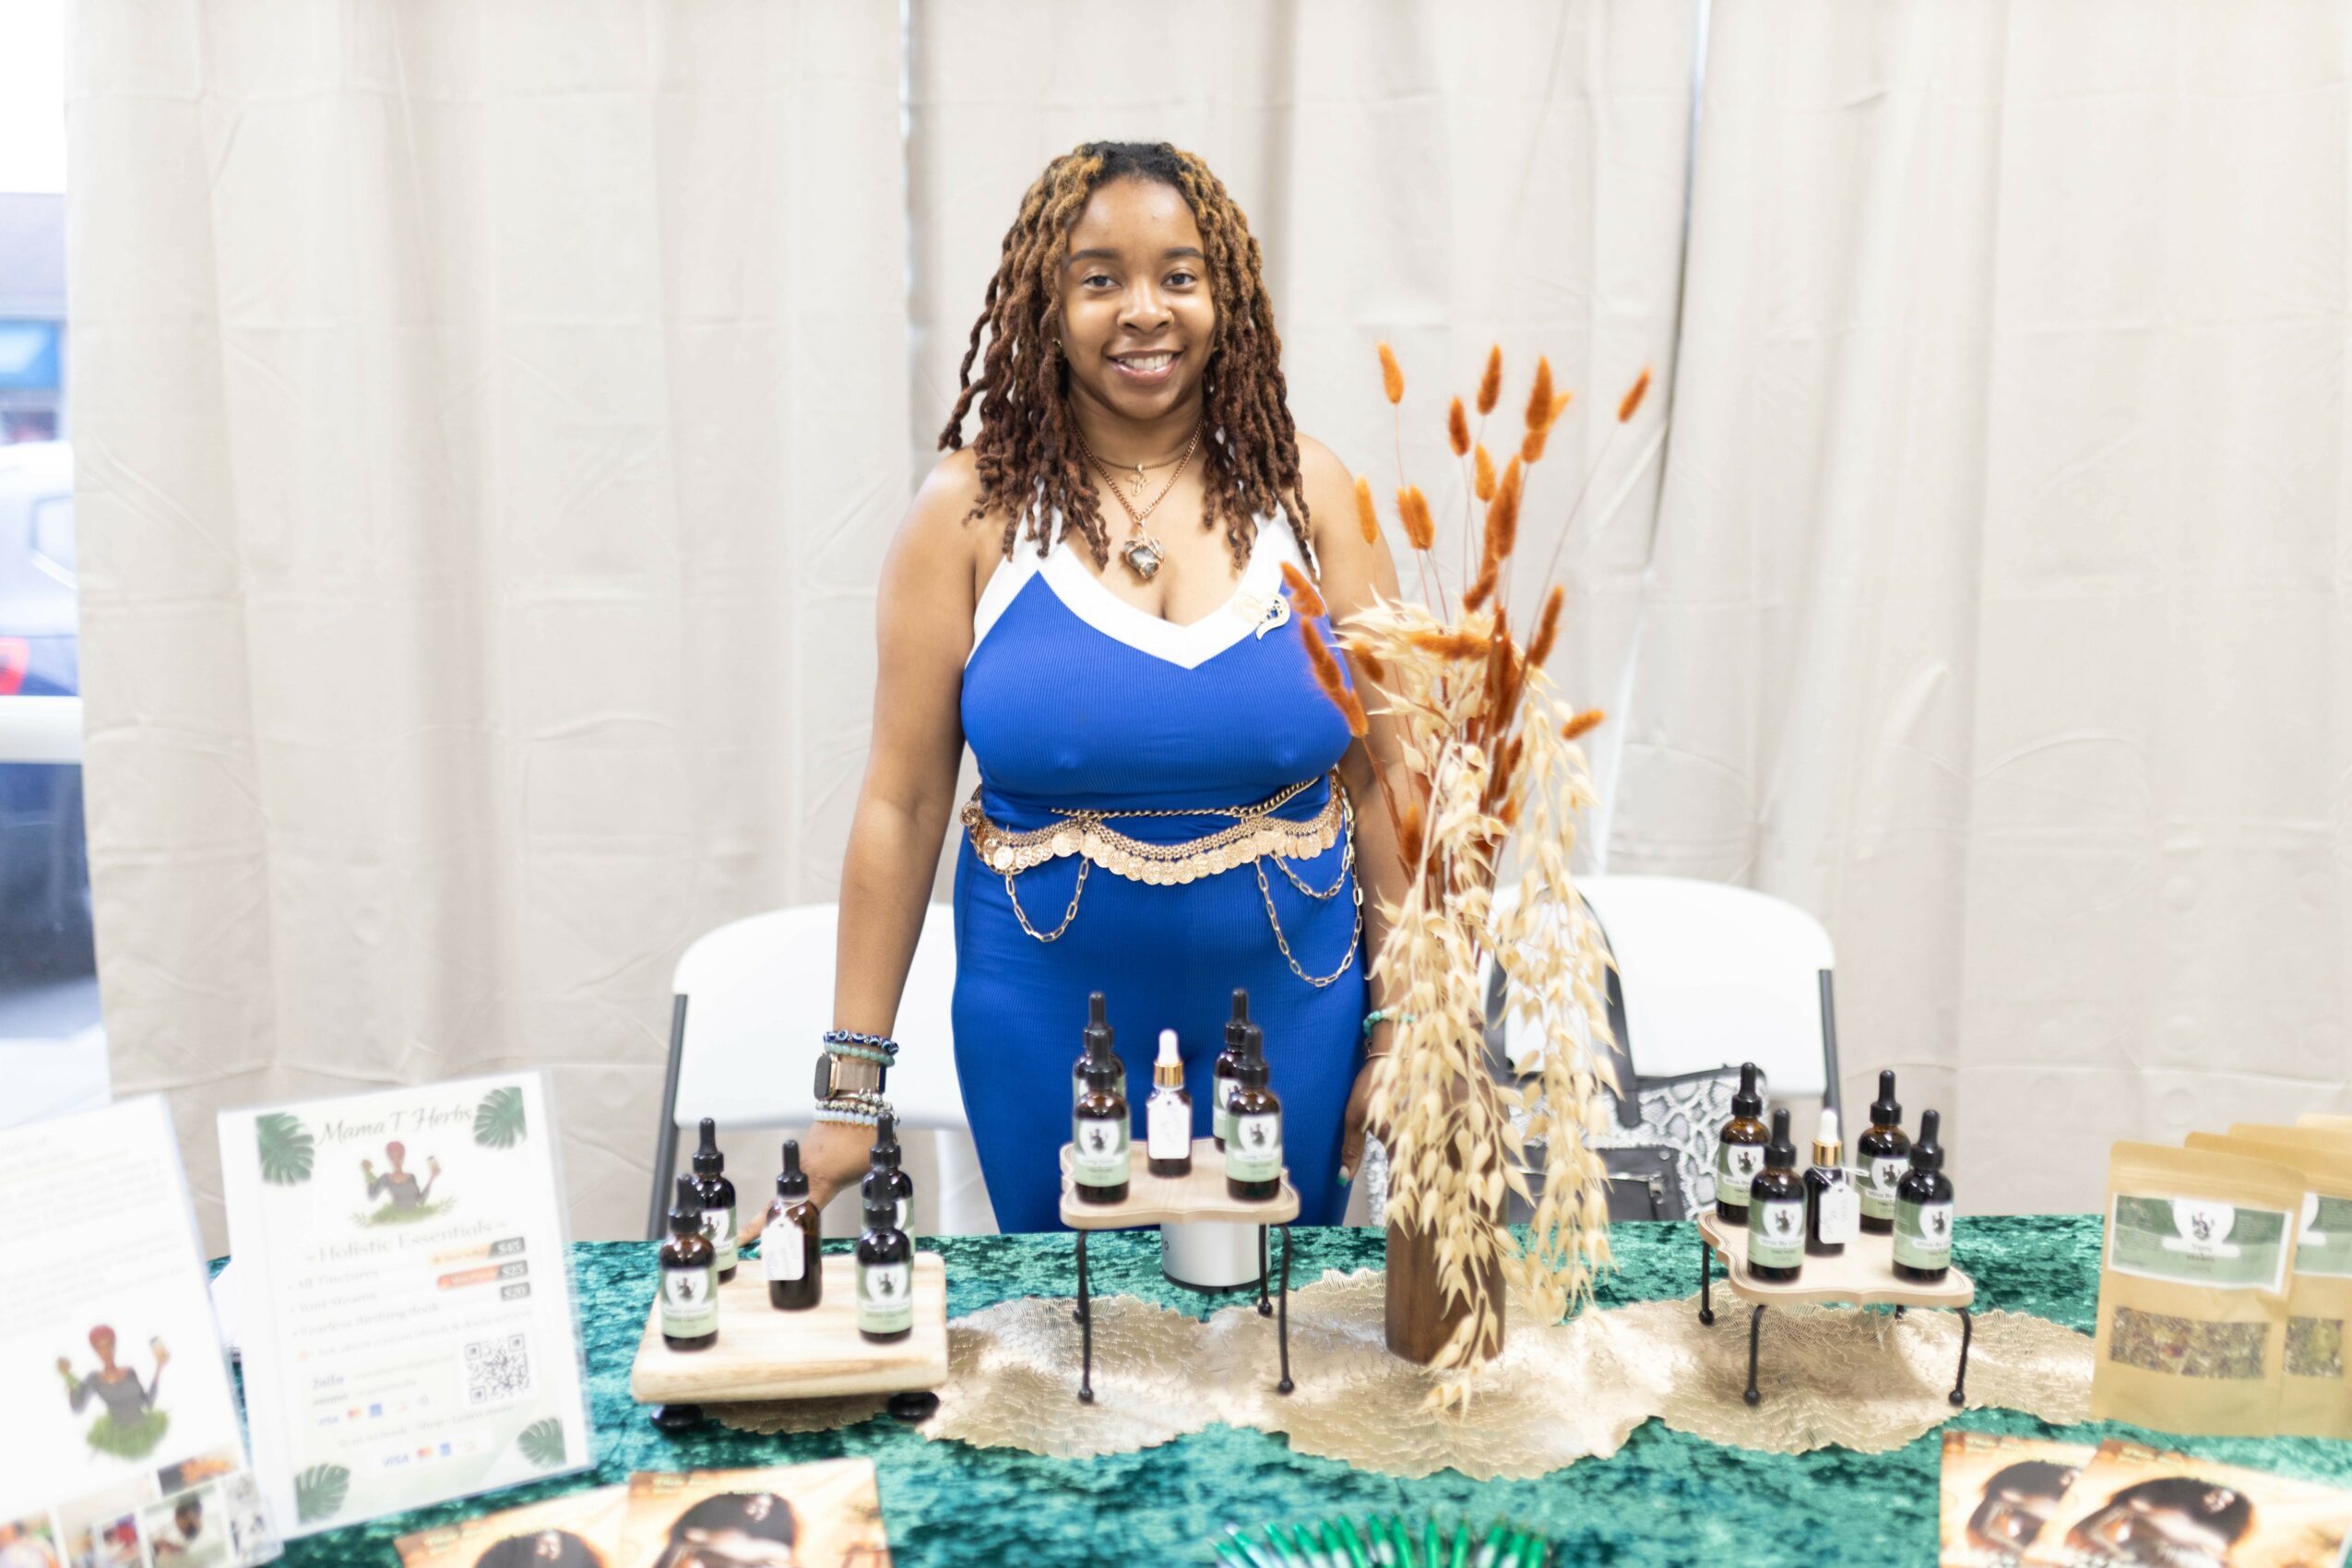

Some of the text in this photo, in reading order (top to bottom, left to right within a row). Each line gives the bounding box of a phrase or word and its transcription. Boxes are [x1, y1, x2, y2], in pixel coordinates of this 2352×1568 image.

[317, 1104, 472, 1145] Mama T Herbs
[318, 1218, 493, 1263] Holistic Essentials
[501, 1262, 525, 1279] $25
[381, 1454, 410, 1469] VISA
